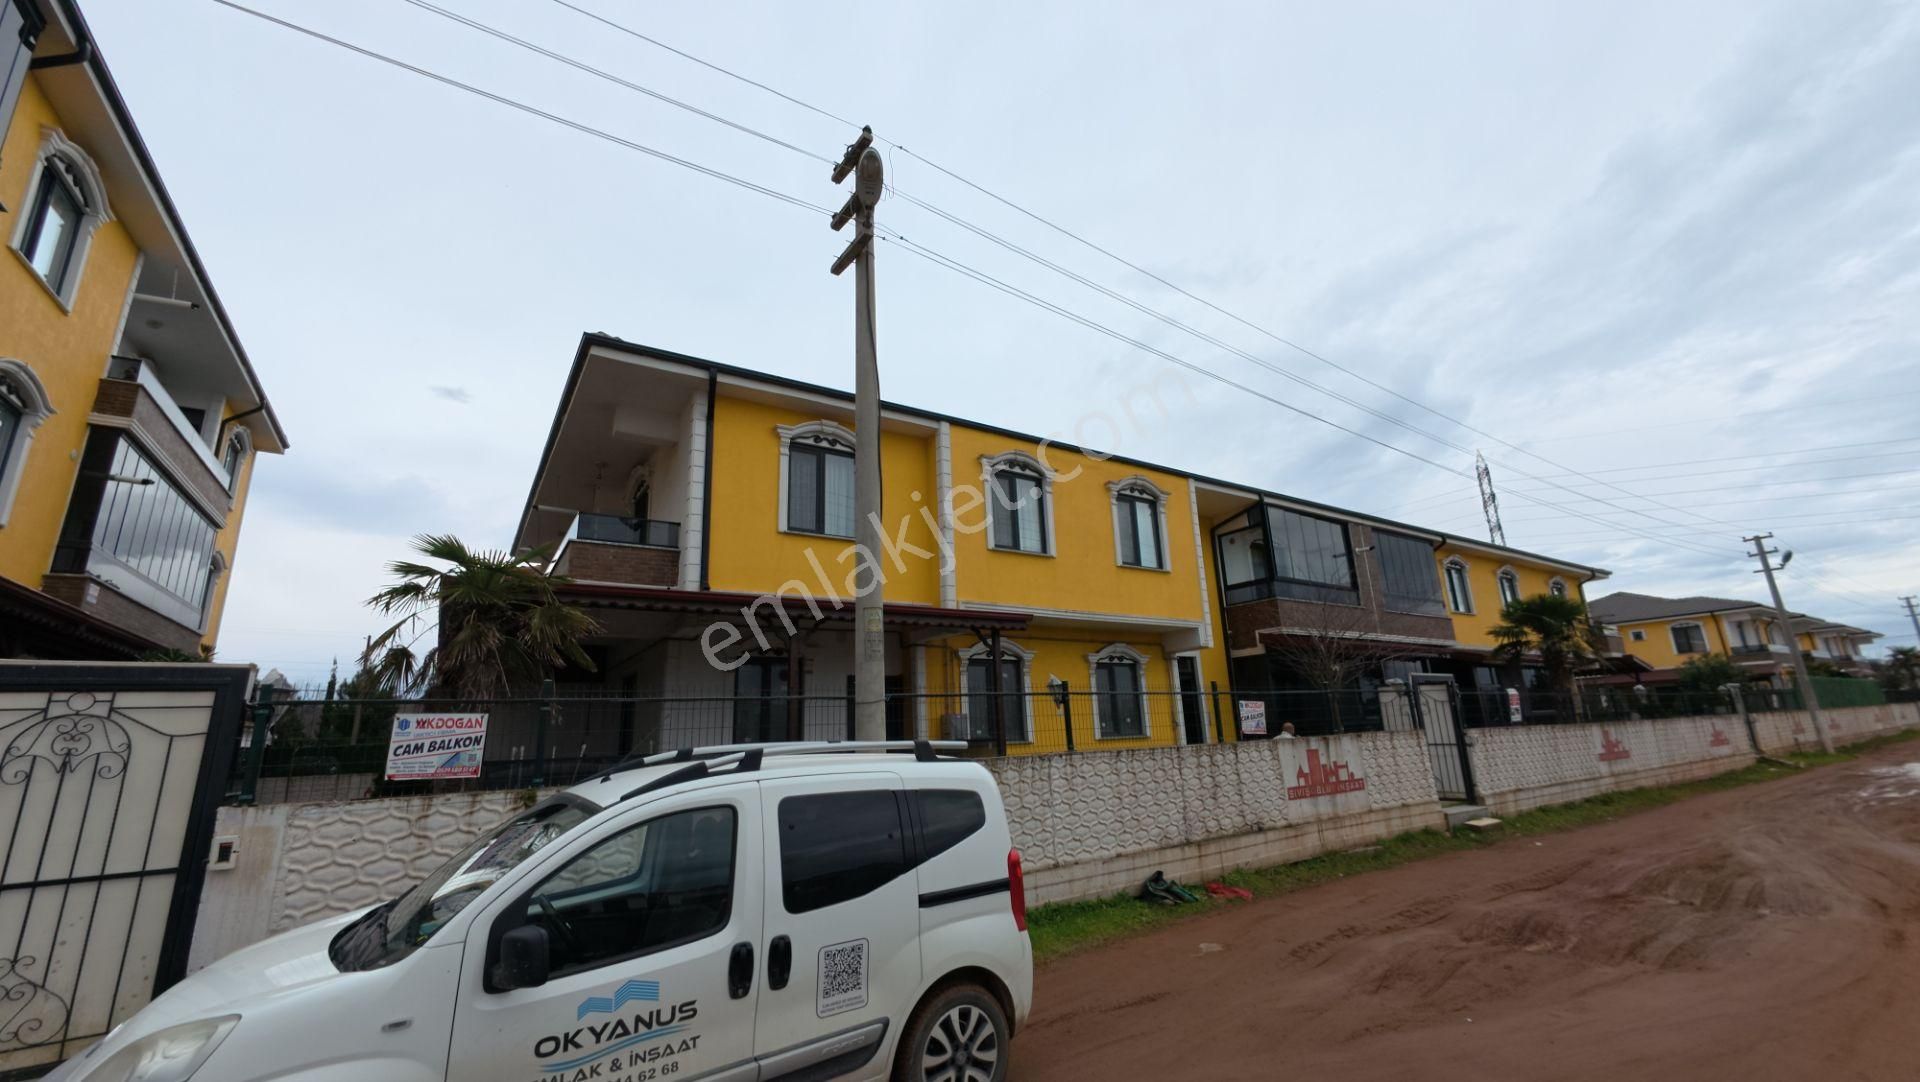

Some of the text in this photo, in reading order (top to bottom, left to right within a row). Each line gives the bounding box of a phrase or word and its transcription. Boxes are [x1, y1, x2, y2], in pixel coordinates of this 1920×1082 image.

[393, 735, 483, 757] CAM BALKON
[534, 999, 698, 1059] OKYANUS
[609, 1057, 623, 1073] &
[629, 1034, 702, 1068] İNŞAAT
[638, 1068, 657, 1082] 62
[661, 1060, 680, 1077] 68
